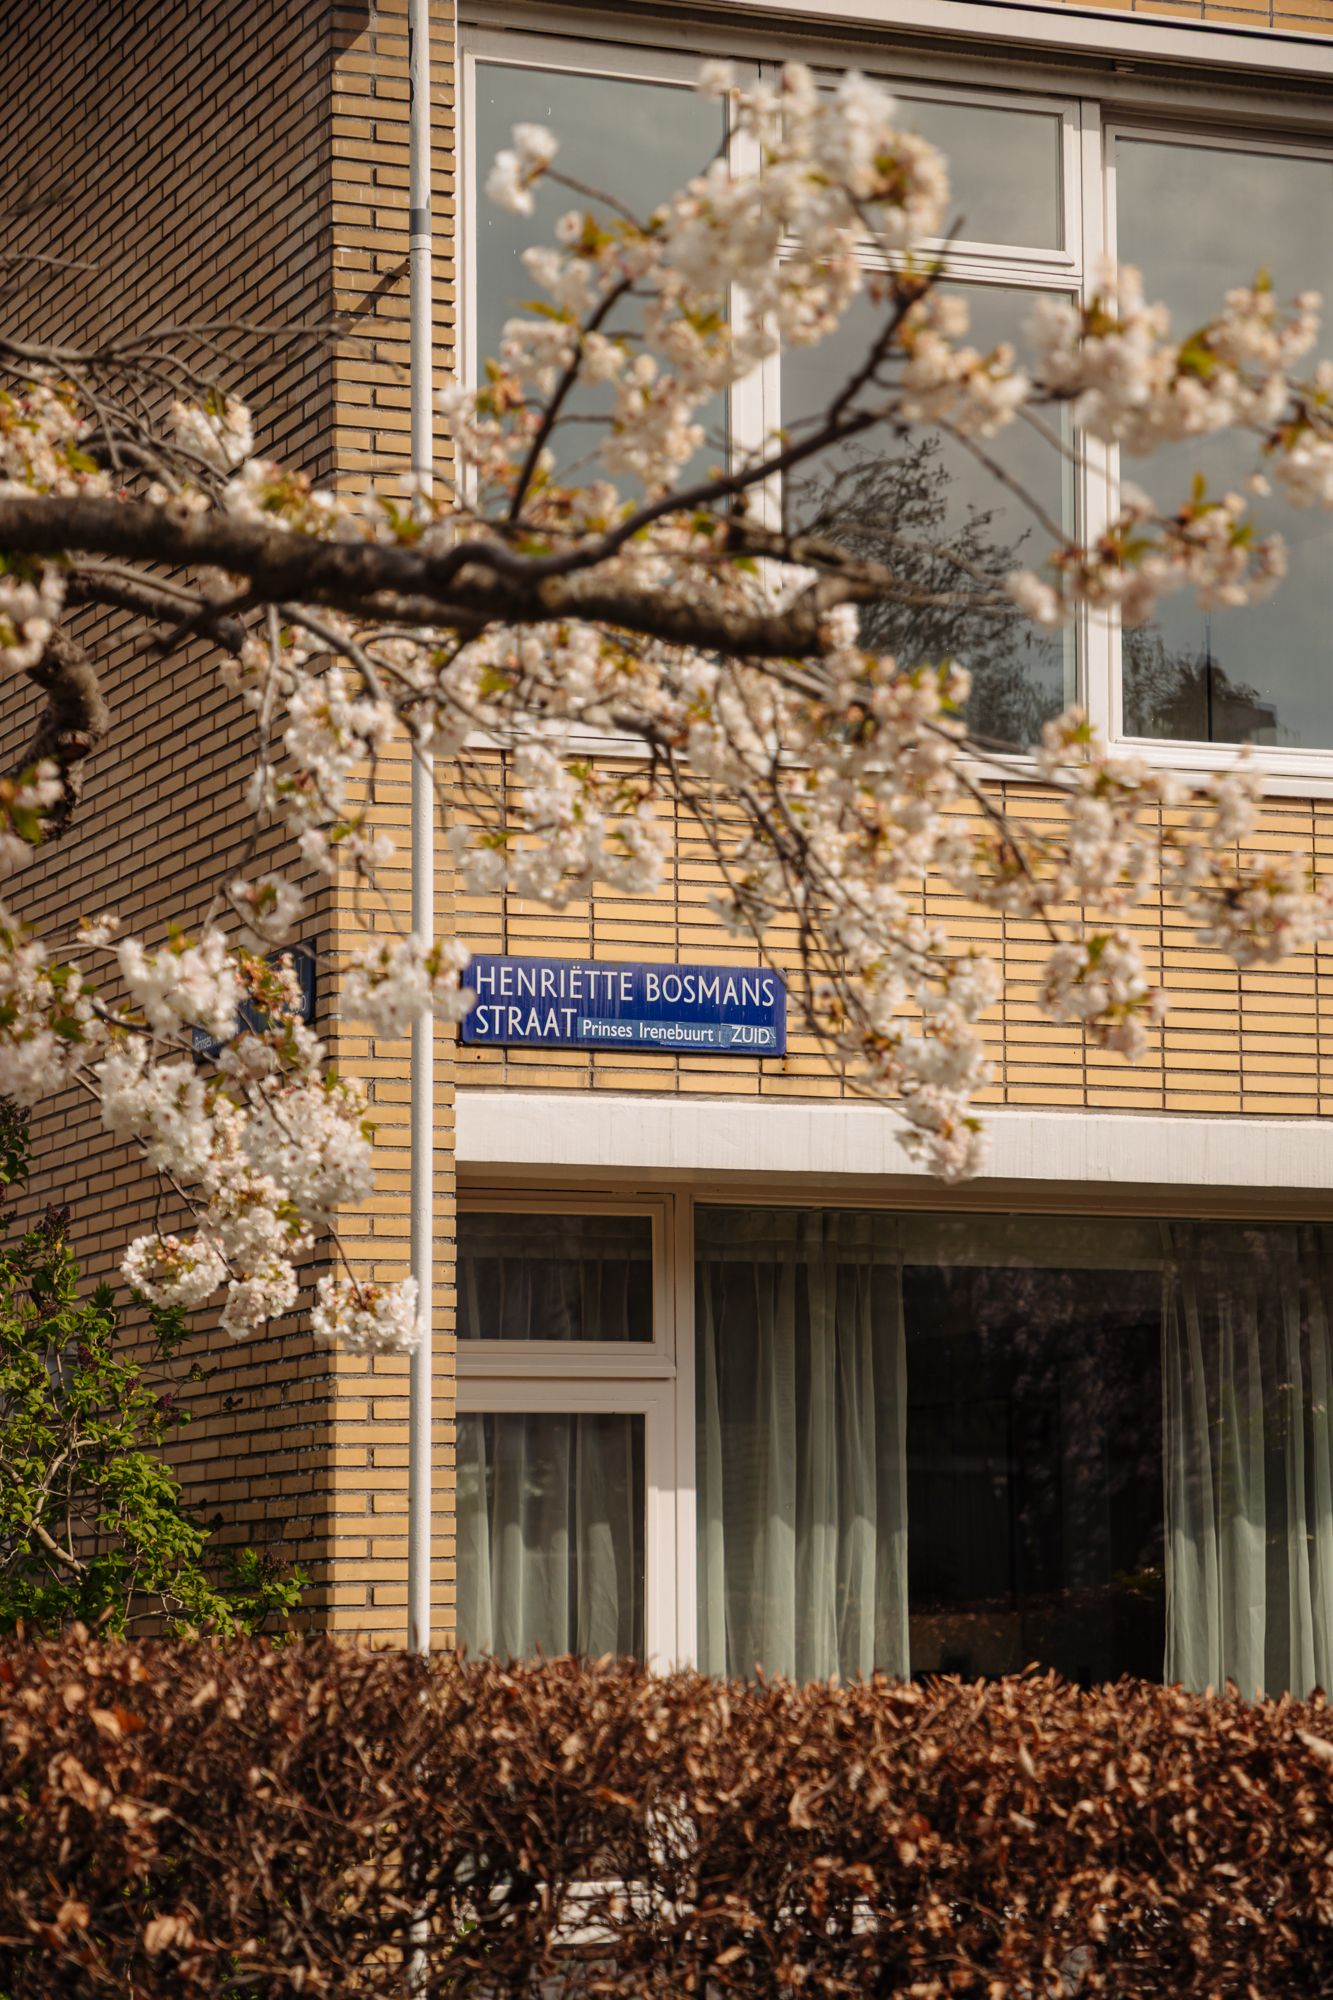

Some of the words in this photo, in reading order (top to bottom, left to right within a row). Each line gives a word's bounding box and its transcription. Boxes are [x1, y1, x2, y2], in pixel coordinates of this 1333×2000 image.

[476, 965, 633, 1001] HENRIËTTE
[646, 973, 775, 1007] BOSMANS
[475, 1005, 578, 1038] STRAAT
[583, 1019, 633, 1038] Prinses
[639, 1022, 714, 1042] Irenebuurt
[731, 1025, 770, 1044] ZUID
